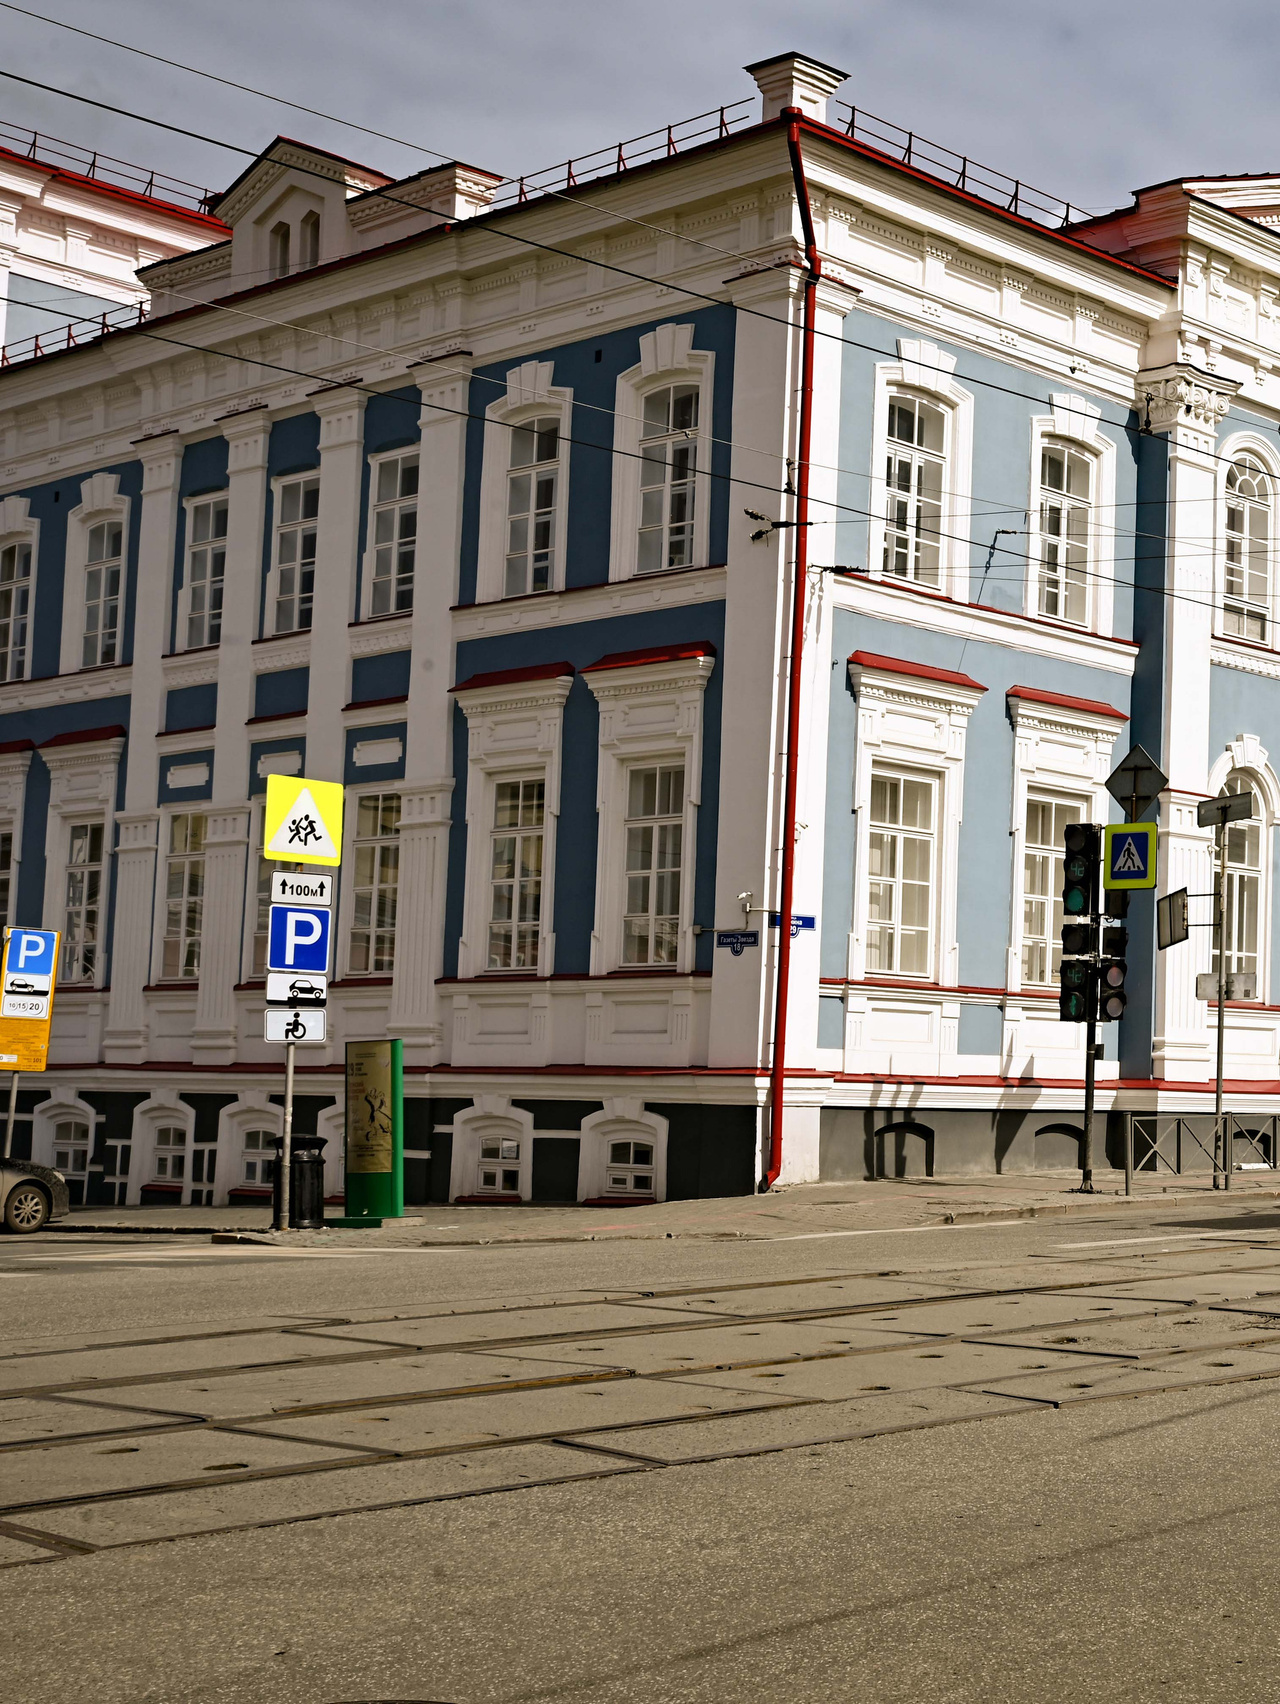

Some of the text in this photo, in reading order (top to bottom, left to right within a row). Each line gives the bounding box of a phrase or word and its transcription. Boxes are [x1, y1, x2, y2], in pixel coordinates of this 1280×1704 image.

[285, 911, 322, 966] P
[733, 943, 741, 951] 18
[18, 934, 46, 969] P
[29, 1002, 40, 1010] 20
